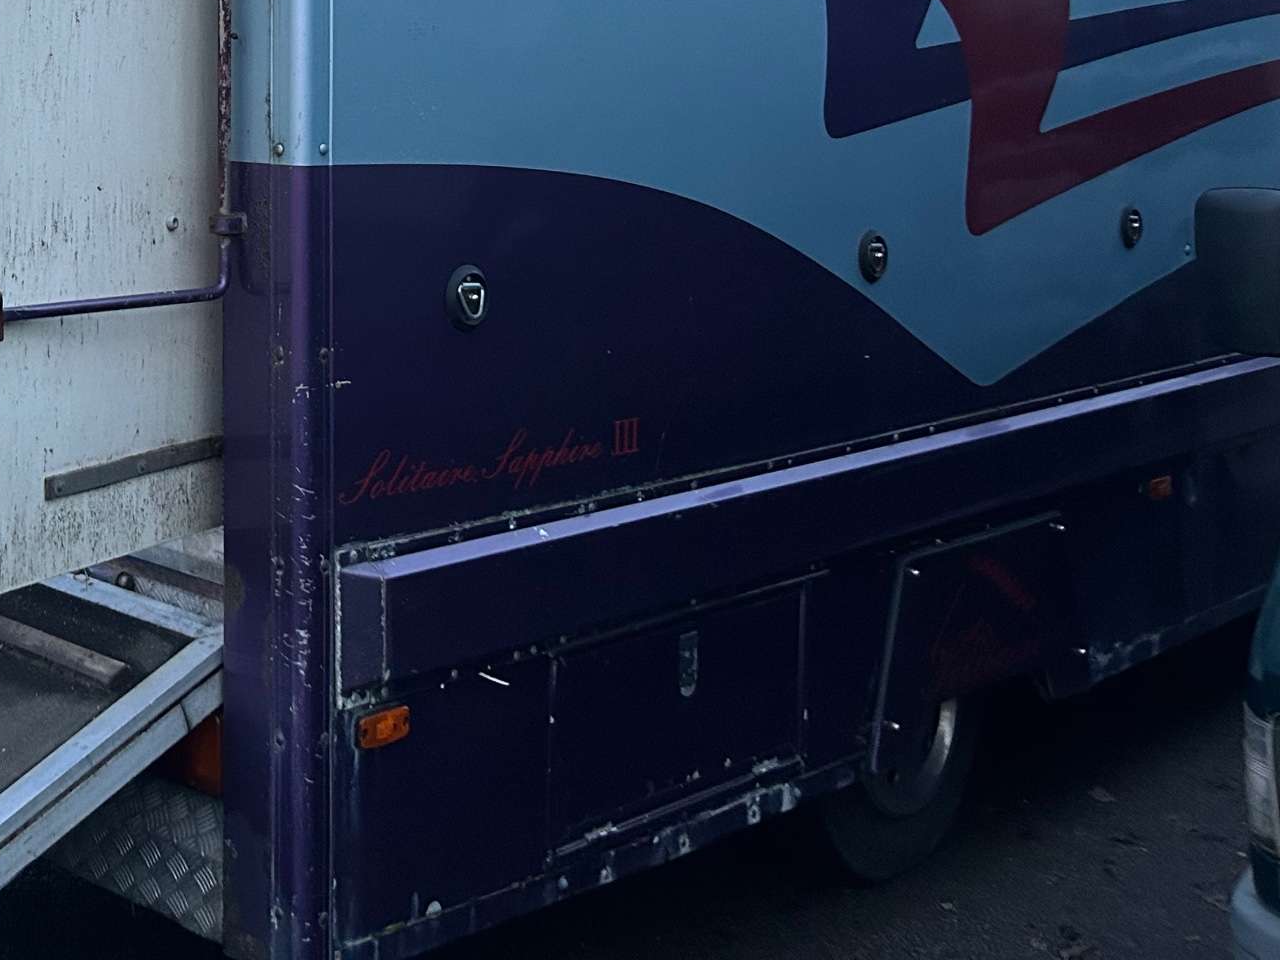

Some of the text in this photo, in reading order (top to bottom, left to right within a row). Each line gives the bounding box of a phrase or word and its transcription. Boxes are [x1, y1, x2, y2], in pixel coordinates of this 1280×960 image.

[338, 417, 640, 504] Solitaire Sapphire III
